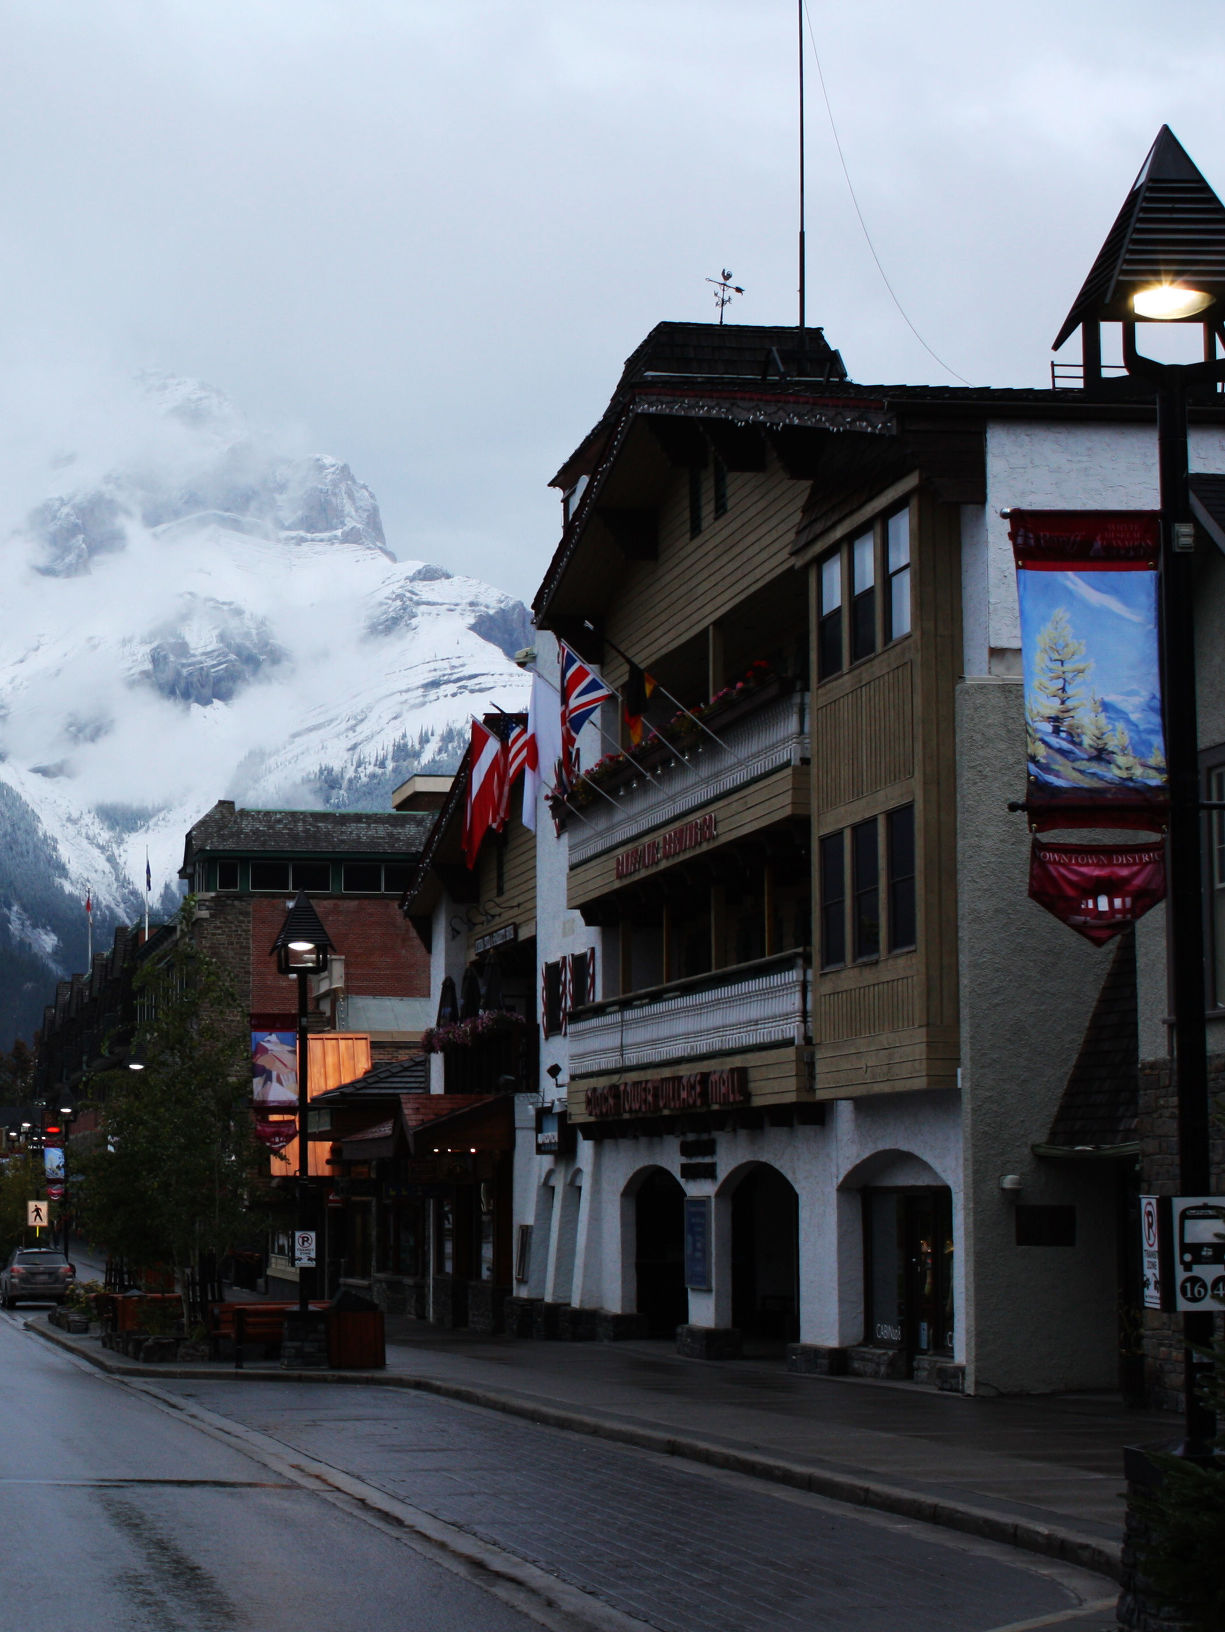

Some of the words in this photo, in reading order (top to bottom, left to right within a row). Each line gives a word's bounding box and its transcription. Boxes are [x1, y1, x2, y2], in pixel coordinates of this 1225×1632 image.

[1037, 850, 1108, 865] OWNTOWN
[1112, 849, 1162, 865] DISTRIC
[619, 1078, 657, 1113] TOWER
[658, 1071, 704, 1109] VILLAGE
[707, 1066, 748, 1105] MALL
[1183, 1281, 1206, 1298] 16
